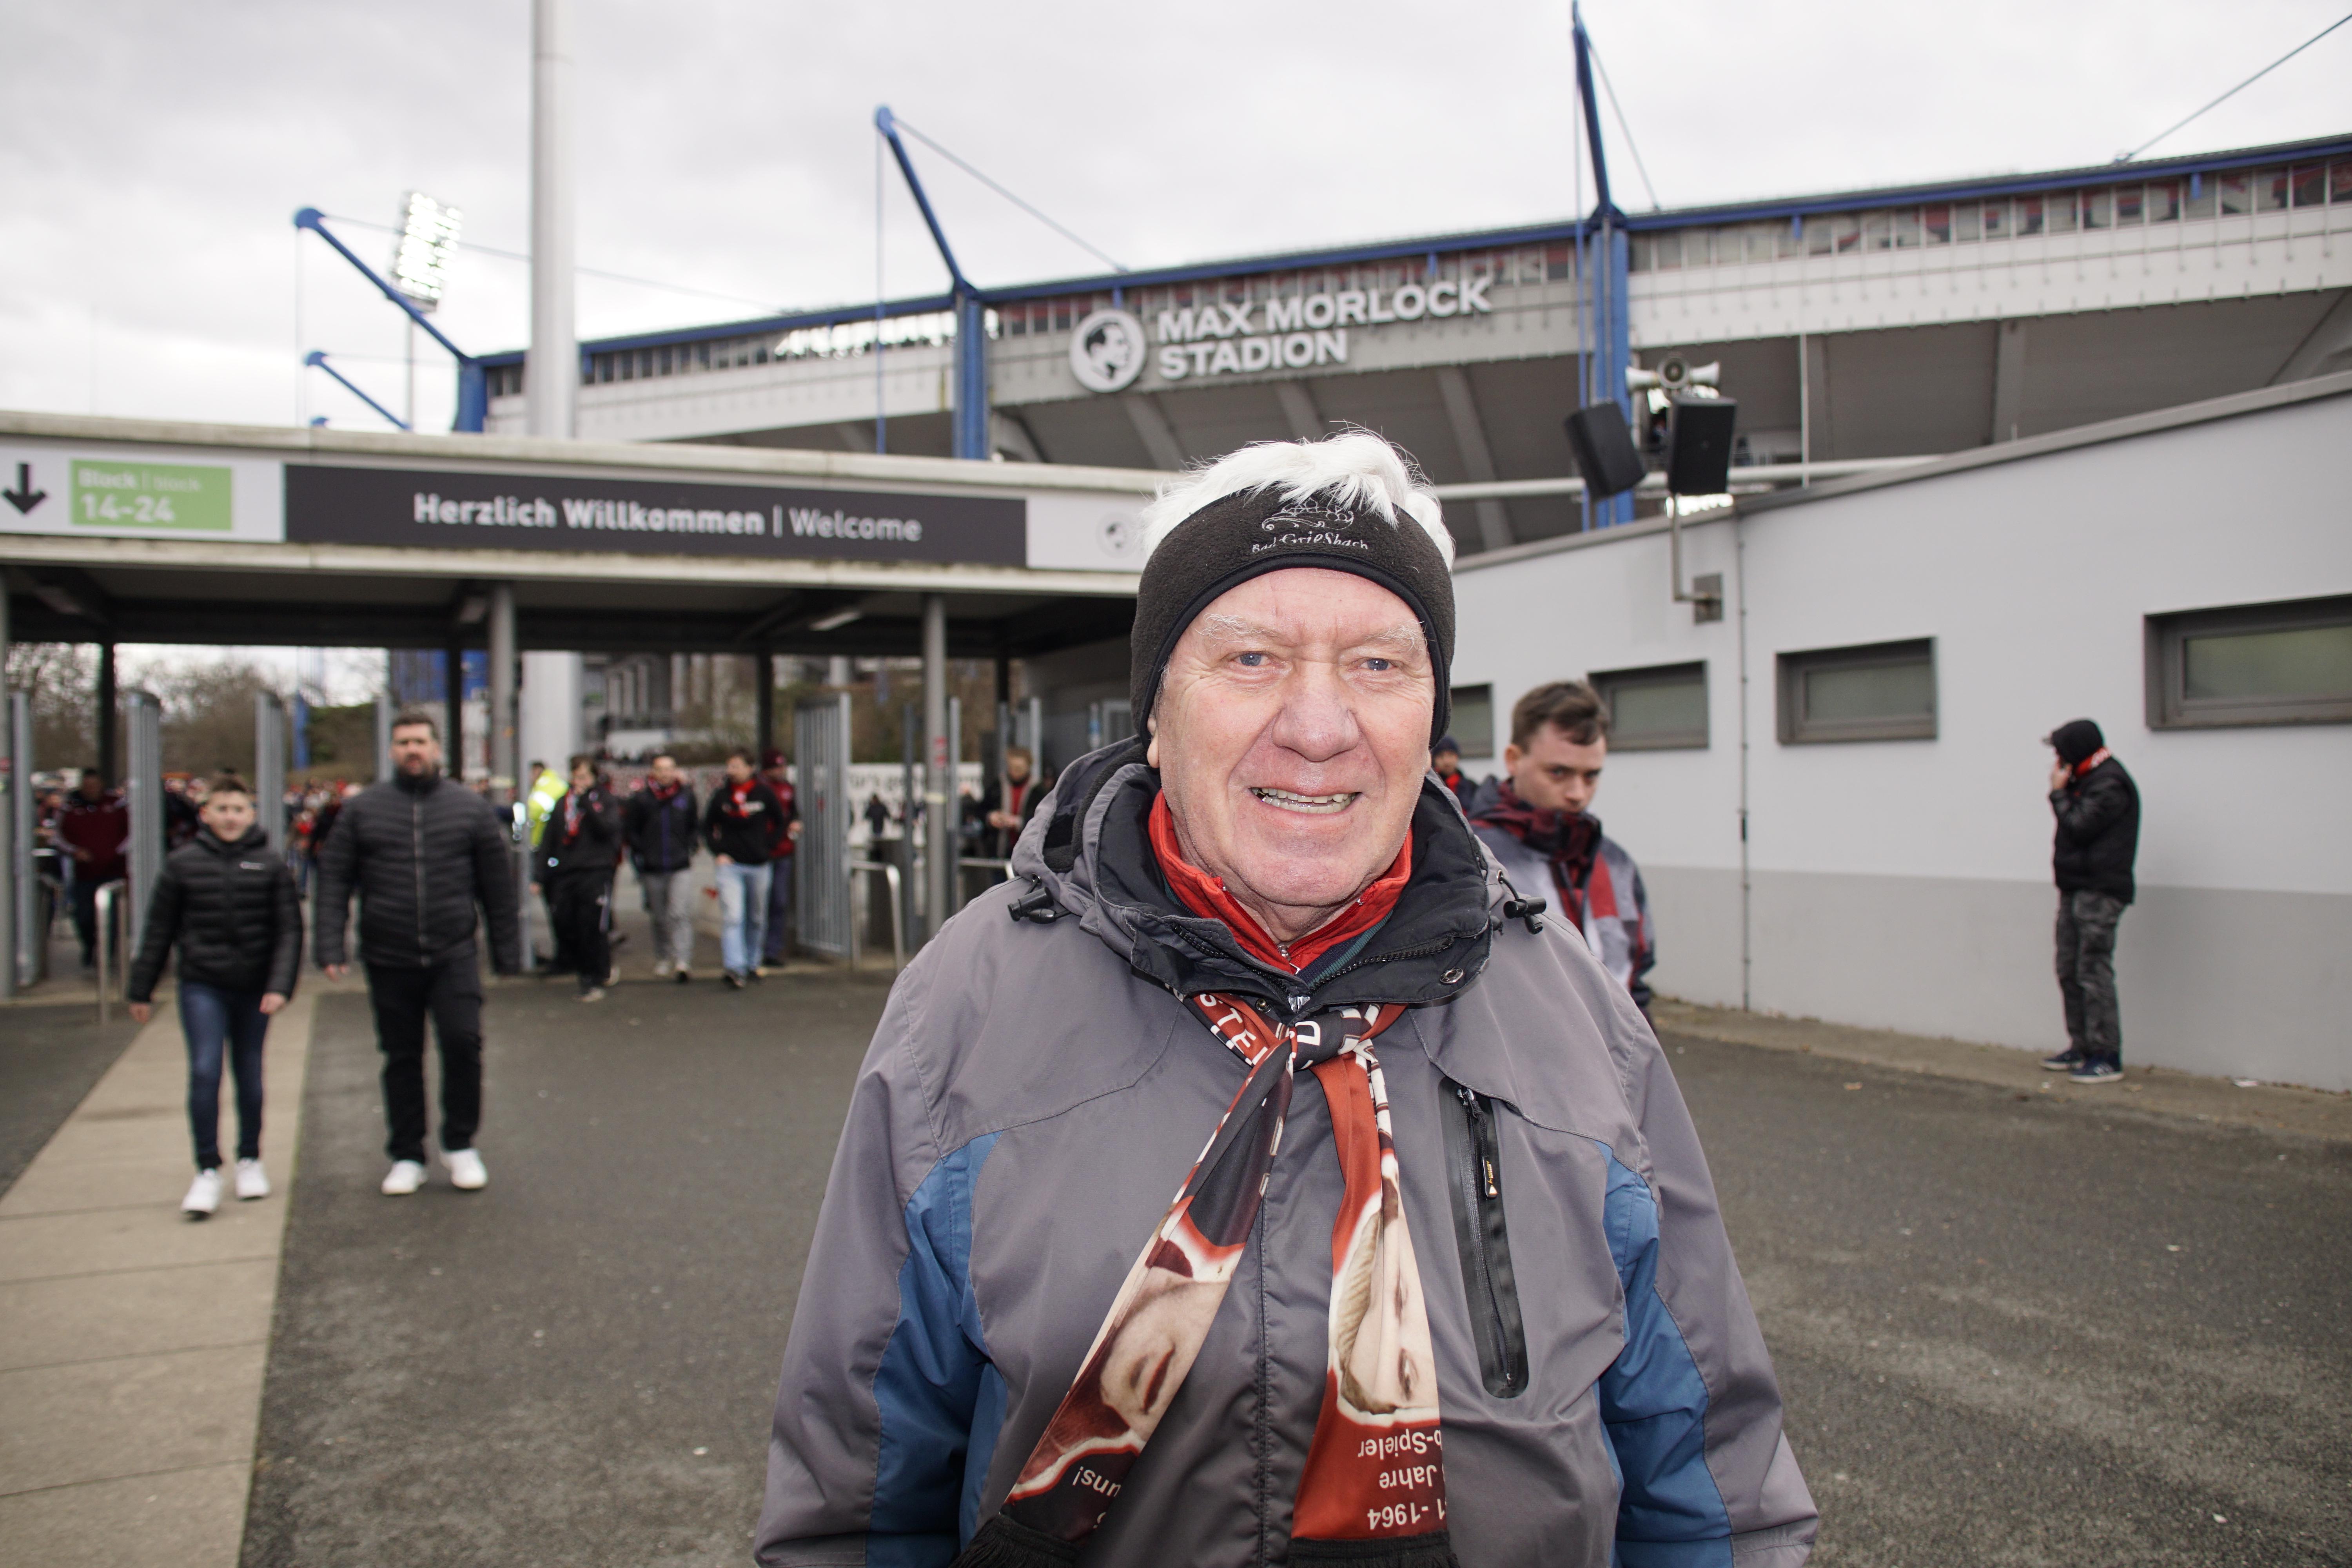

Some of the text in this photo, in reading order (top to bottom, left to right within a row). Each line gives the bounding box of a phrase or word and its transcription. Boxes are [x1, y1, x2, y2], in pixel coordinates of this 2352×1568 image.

[1158, 276, 1492, 343] MAX MORLOCK
[1159, 328, 1347, 380] STADION
[79, 468, 201, 493] Block block
[81, 493, 176, 523] 14-24
[414, 492, 922, 541] Herzlich Willkommen Welcome
[1072, 1466, 1122, 1497] uns!
[1379, 1465, 1437, 1490] Jahre
